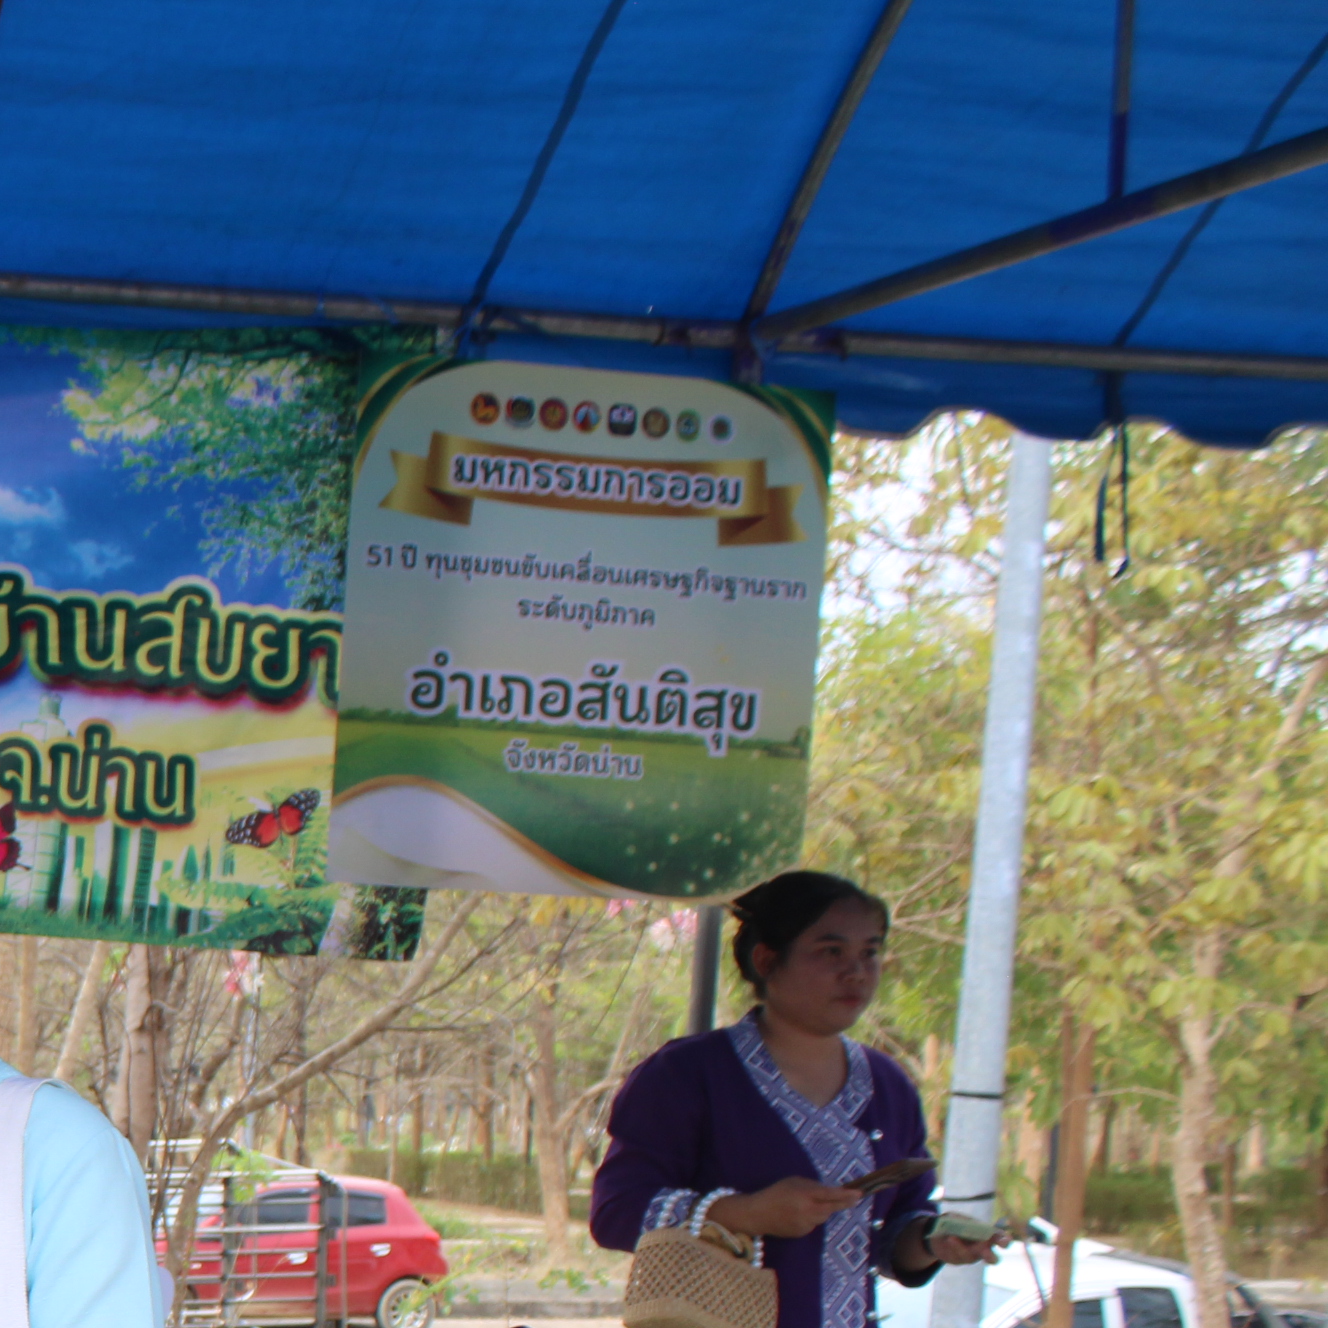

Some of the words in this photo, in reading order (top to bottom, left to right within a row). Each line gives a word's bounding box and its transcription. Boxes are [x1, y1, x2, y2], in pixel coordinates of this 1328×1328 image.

[452, 454, 743, 507] มหกรรมการออม
[366, 544, 393, 567] 51
[400, 543, 419, 570] ปี
[517, 593, 656, 631] ระดับภูมิภาค
[410, 651, 759, 751] อำเภอสันติสุข
[505, 739, 643, 777] จังหวัดน่าน
